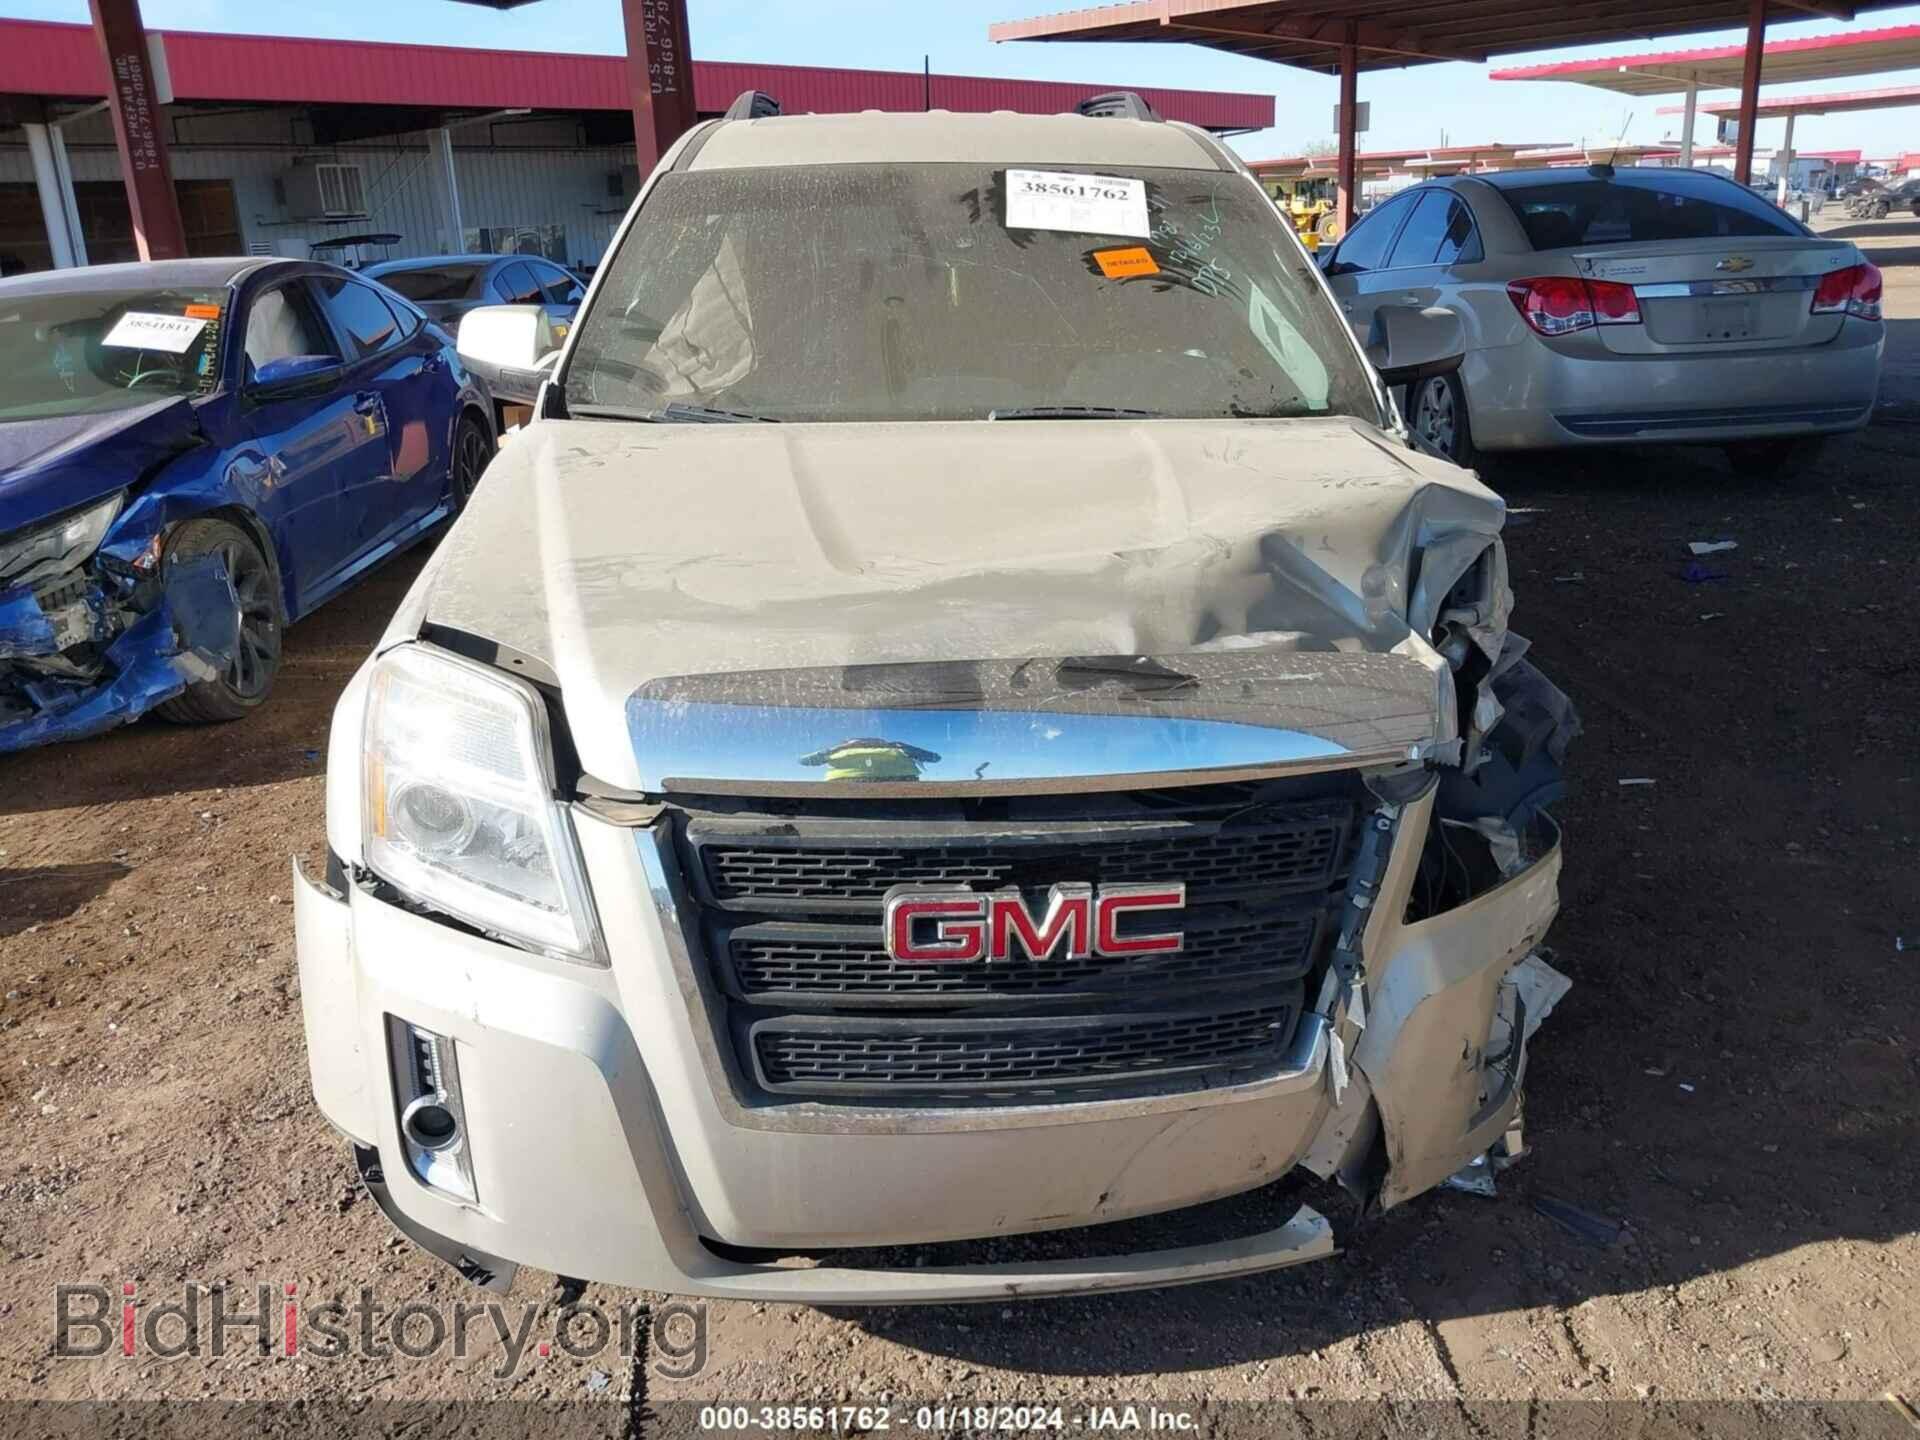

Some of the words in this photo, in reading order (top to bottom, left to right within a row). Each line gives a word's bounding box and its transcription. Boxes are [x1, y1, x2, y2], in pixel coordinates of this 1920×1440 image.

[649, 57, 663, 94] U.S.
[1020, 181, 1129, 201] 38561762
[884, 881, 1186, 965] GMC
